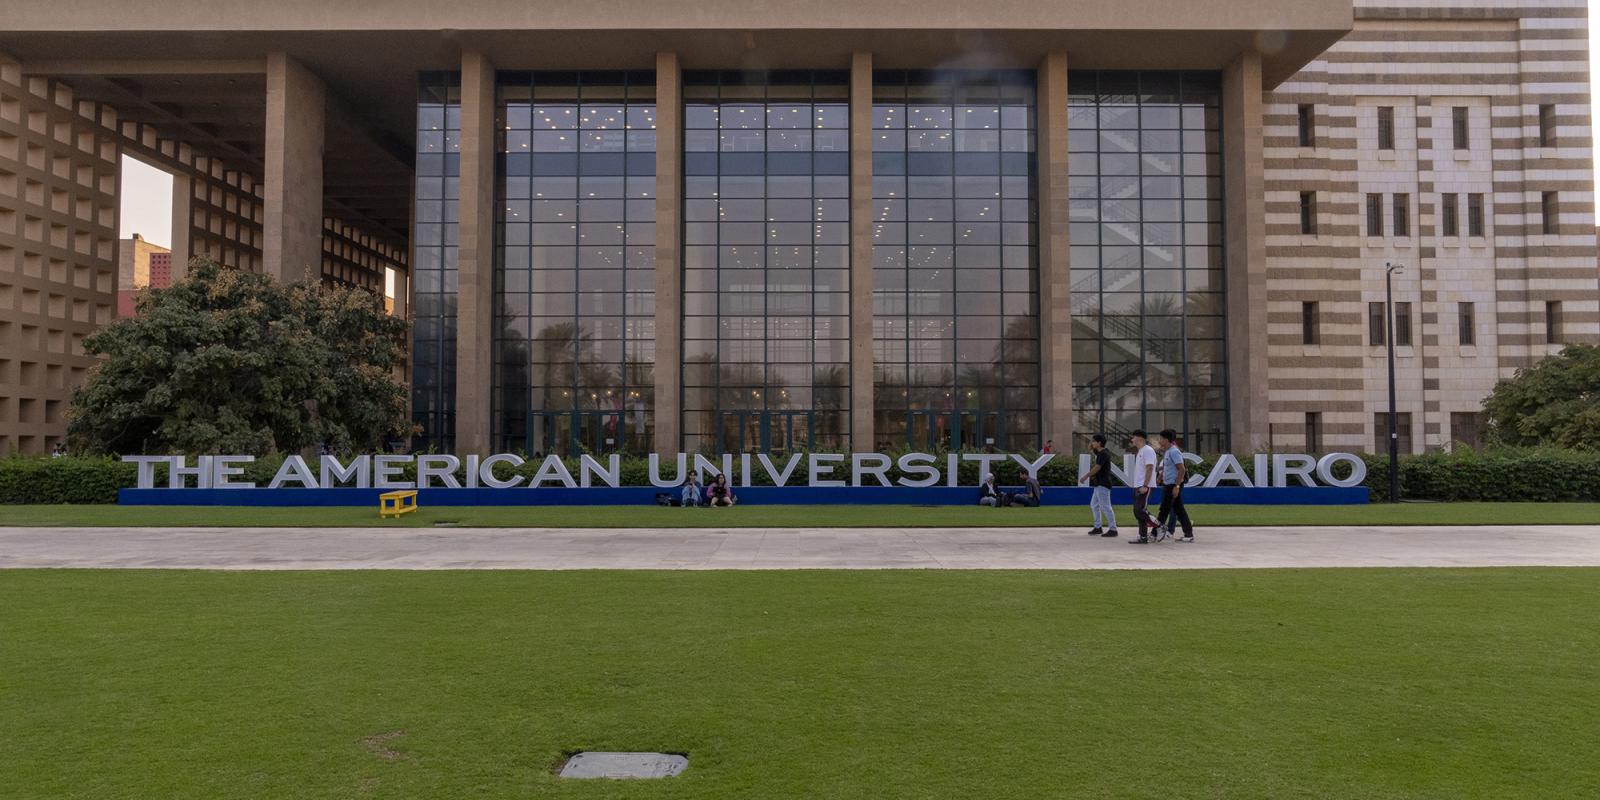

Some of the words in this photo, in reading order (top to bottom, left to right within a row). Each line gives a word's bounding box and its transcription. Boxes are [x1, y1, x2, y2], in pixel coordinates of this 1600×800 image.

[121, 455, 256, 489] THE
[268, 453, 620, 489] AMERICAN
[649, 452, 1056, 488] UNIVERSITY
